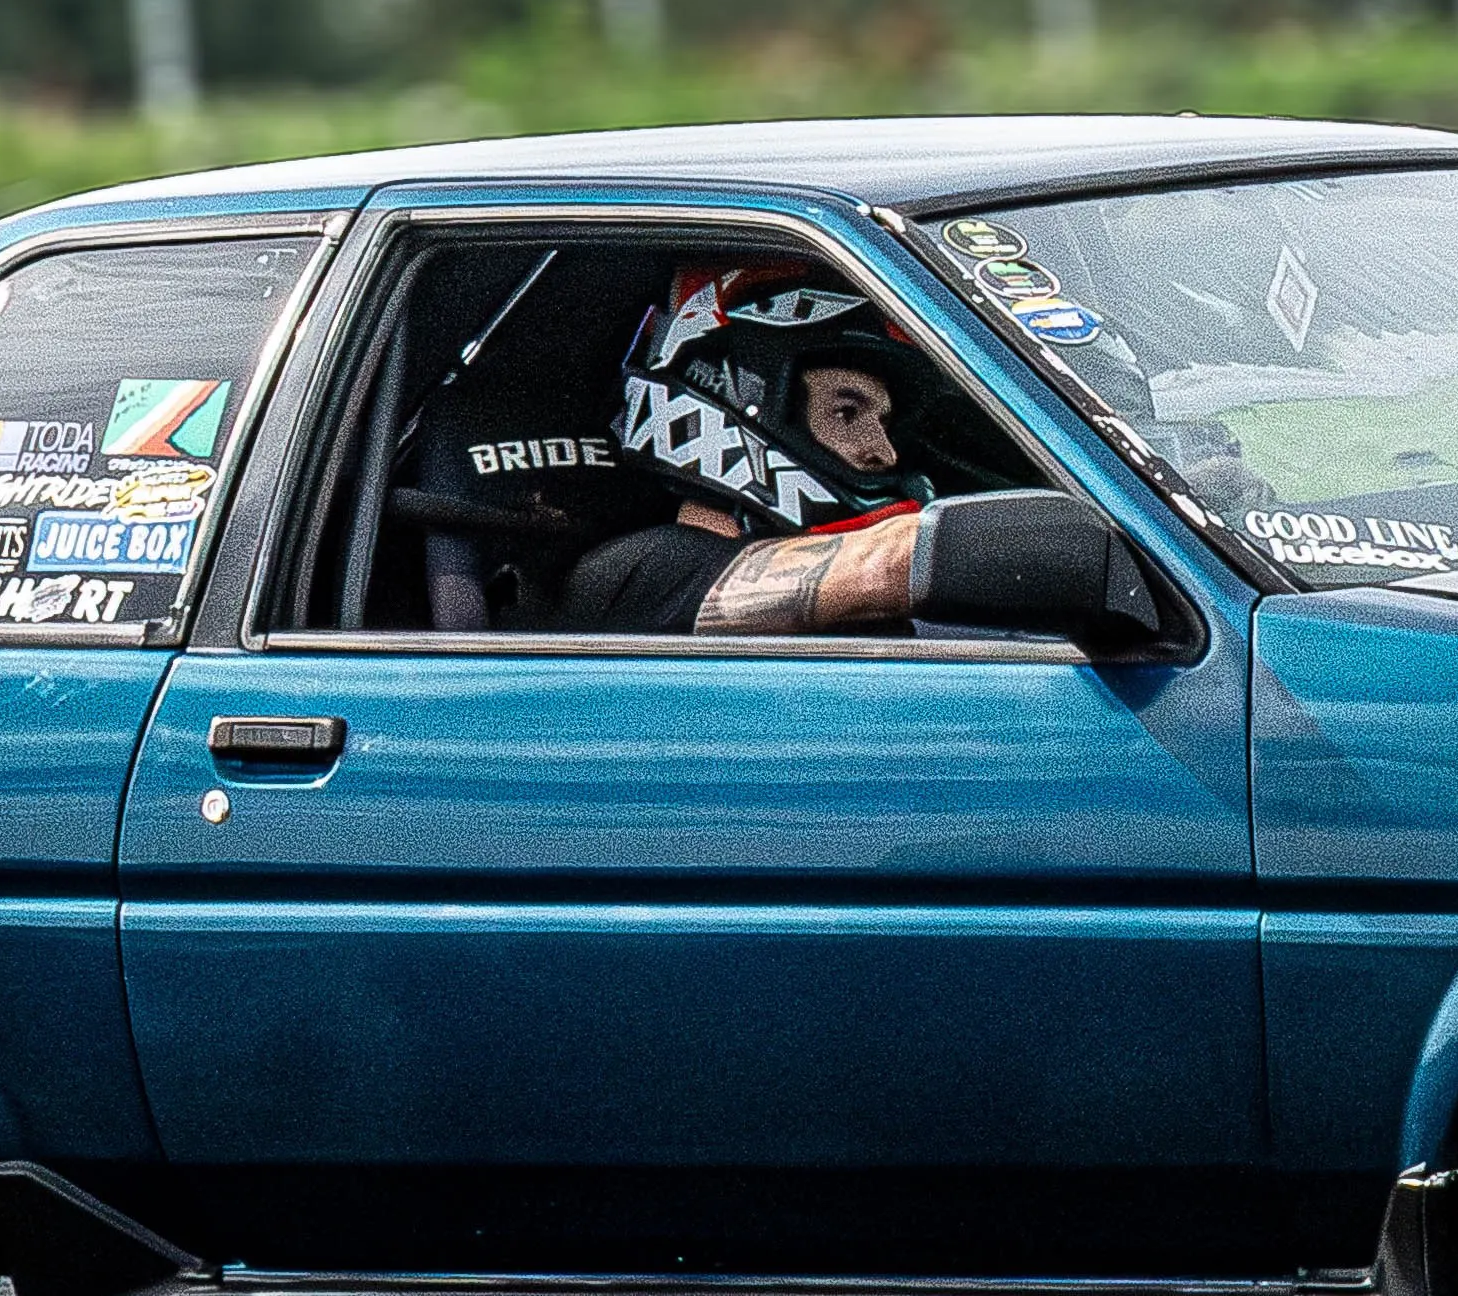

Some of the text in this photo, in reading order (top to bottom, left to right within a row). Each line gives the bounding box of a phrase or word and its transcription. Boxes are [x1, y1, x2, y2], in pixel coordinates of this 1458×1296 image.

[29, 421, 93, 453] TODA
[17, 452, 90, 473] RACING
[468, 437, 616, 474] BRIDE
[36, 522, 188, 561] JUICE BOX
[1245, 510, 1357, 543] GOOD
